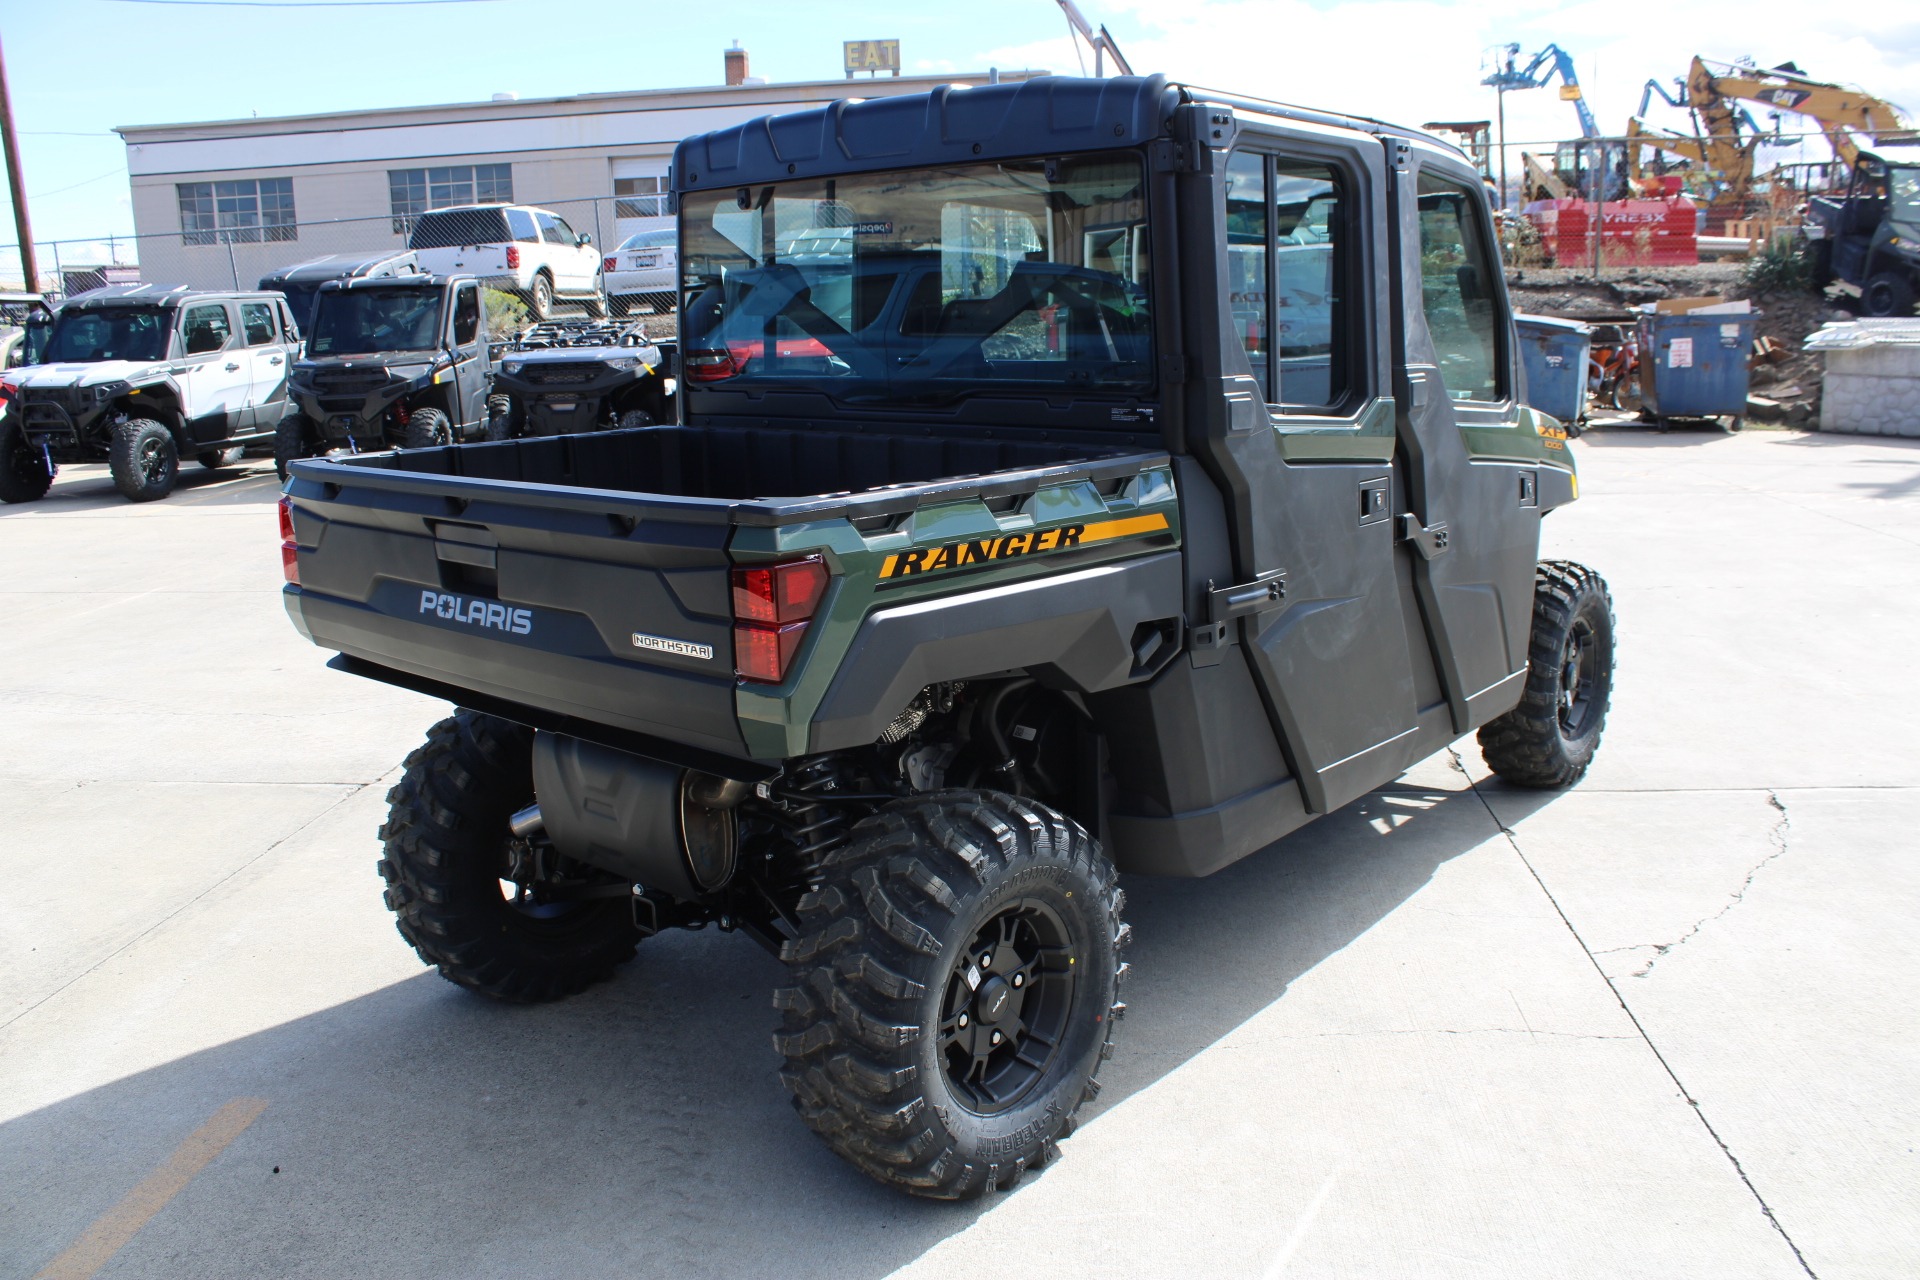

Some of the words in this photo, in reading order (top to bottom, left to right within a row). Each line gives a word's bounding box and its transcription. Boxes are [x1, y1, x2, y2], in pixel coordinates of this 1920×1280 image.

[846, 41, 897, 68] EAT
[1772, 90, 1798, 107] CAT
[1540, 424, 1564, 438] XP
[890, 524, 1085, 579] RANGER
[419, 590, 532, 635] POLARIS
[634, 635, 709, 657] NORTHSTAR
[976, 1099, 1062, 1157] X-TERRAIN
